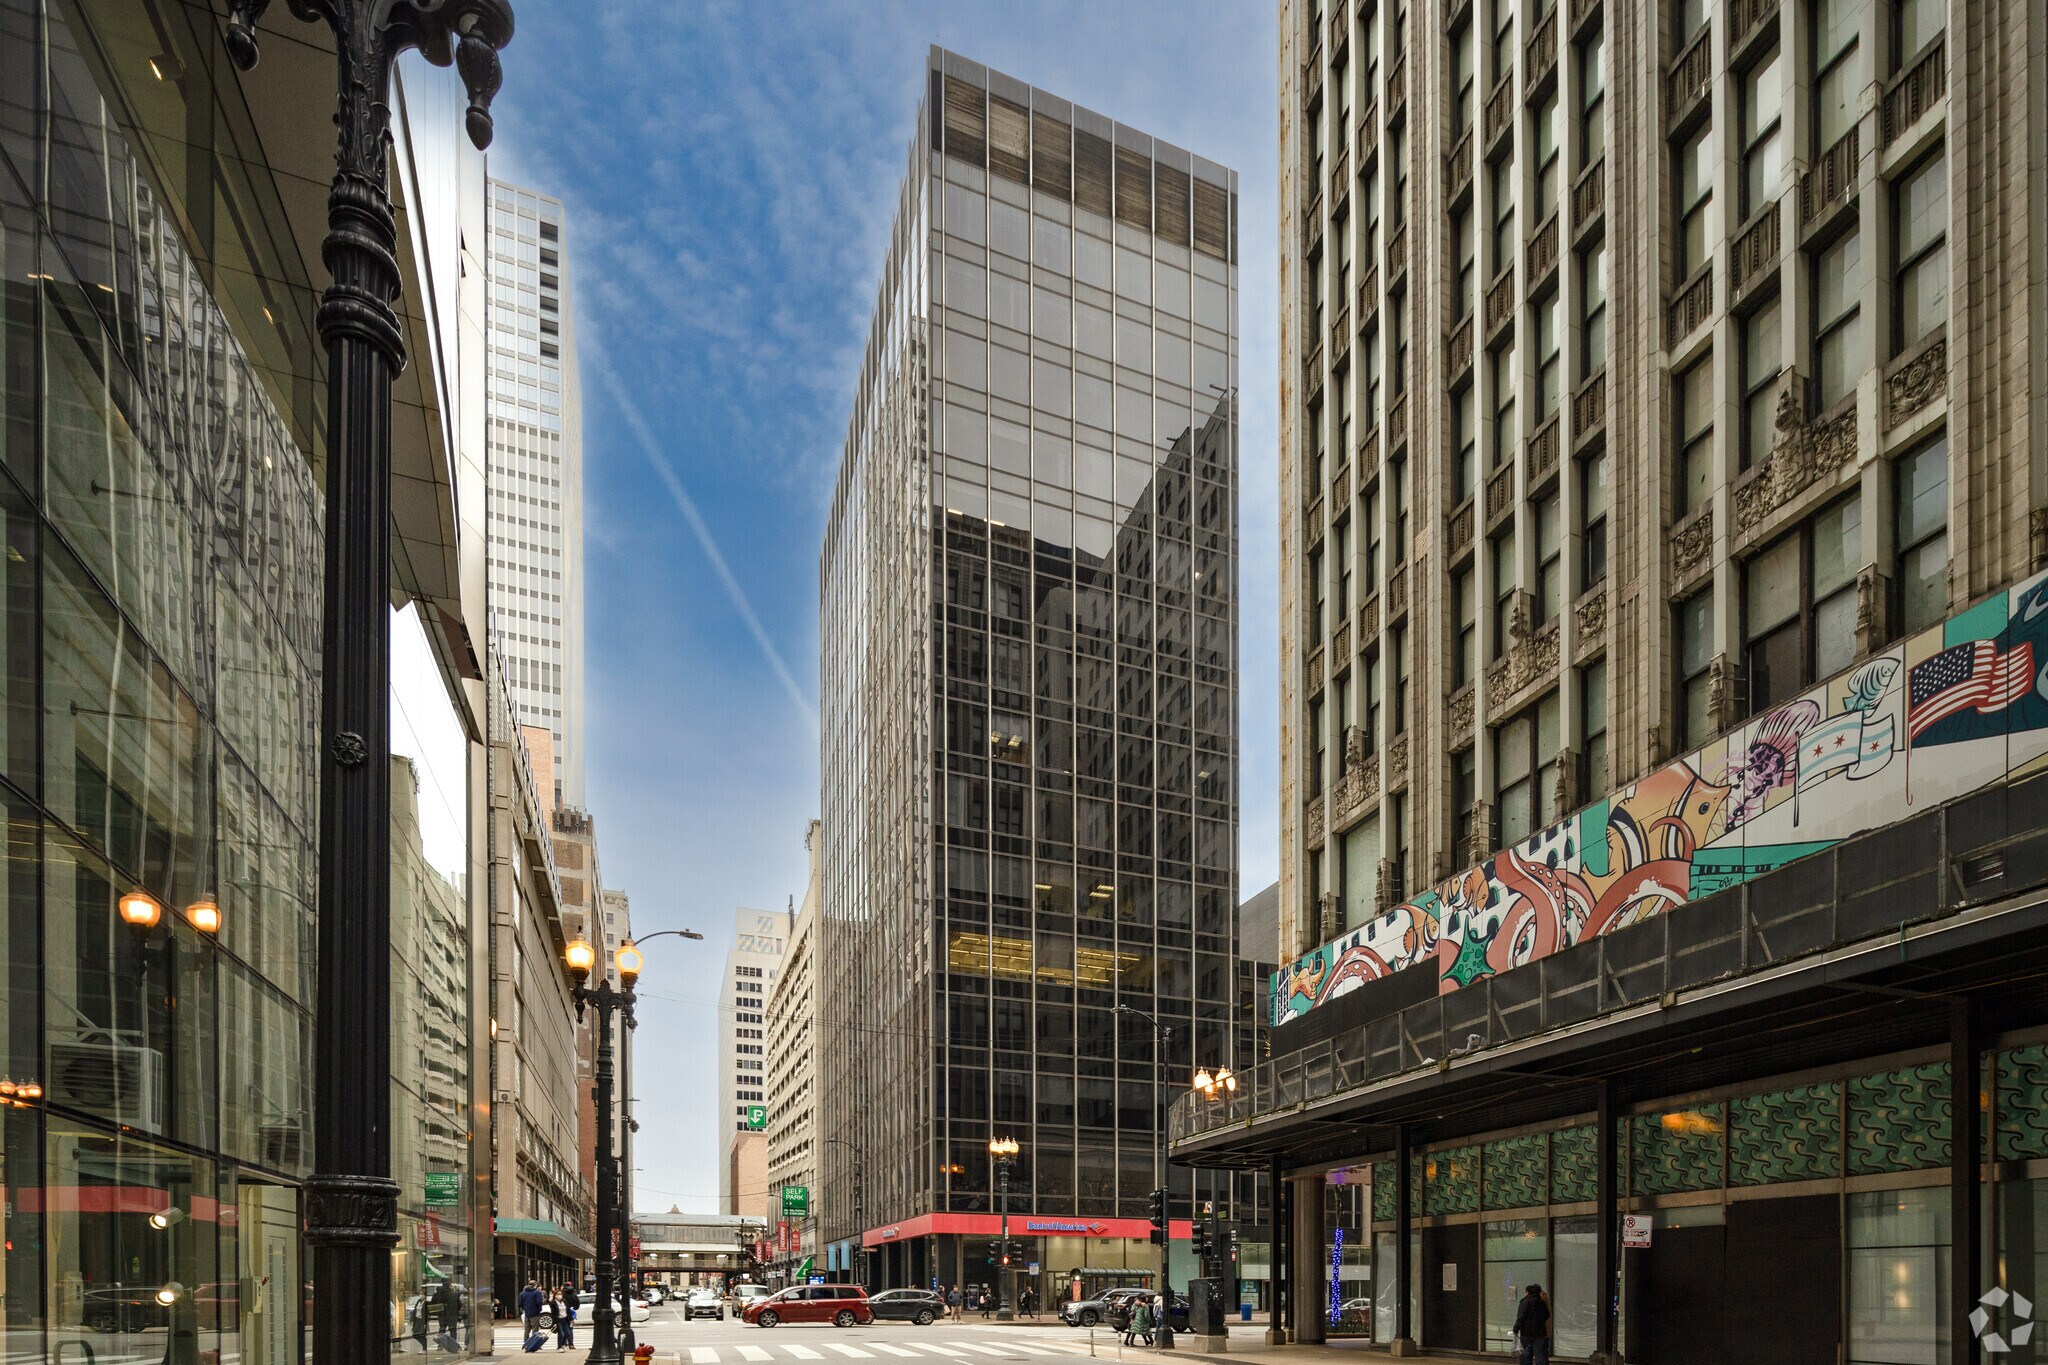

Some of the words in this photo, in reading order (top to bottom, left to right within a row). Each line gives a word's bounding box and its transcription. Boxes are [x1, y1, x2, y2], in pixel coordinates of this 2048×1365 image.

[785, 1187, 803, 1195] SELF
[1027, 1221, 1047, 1230] Bank
[1047, 1222, 1056, 1230] of
[1056, 1221, 1087, 1231] America
